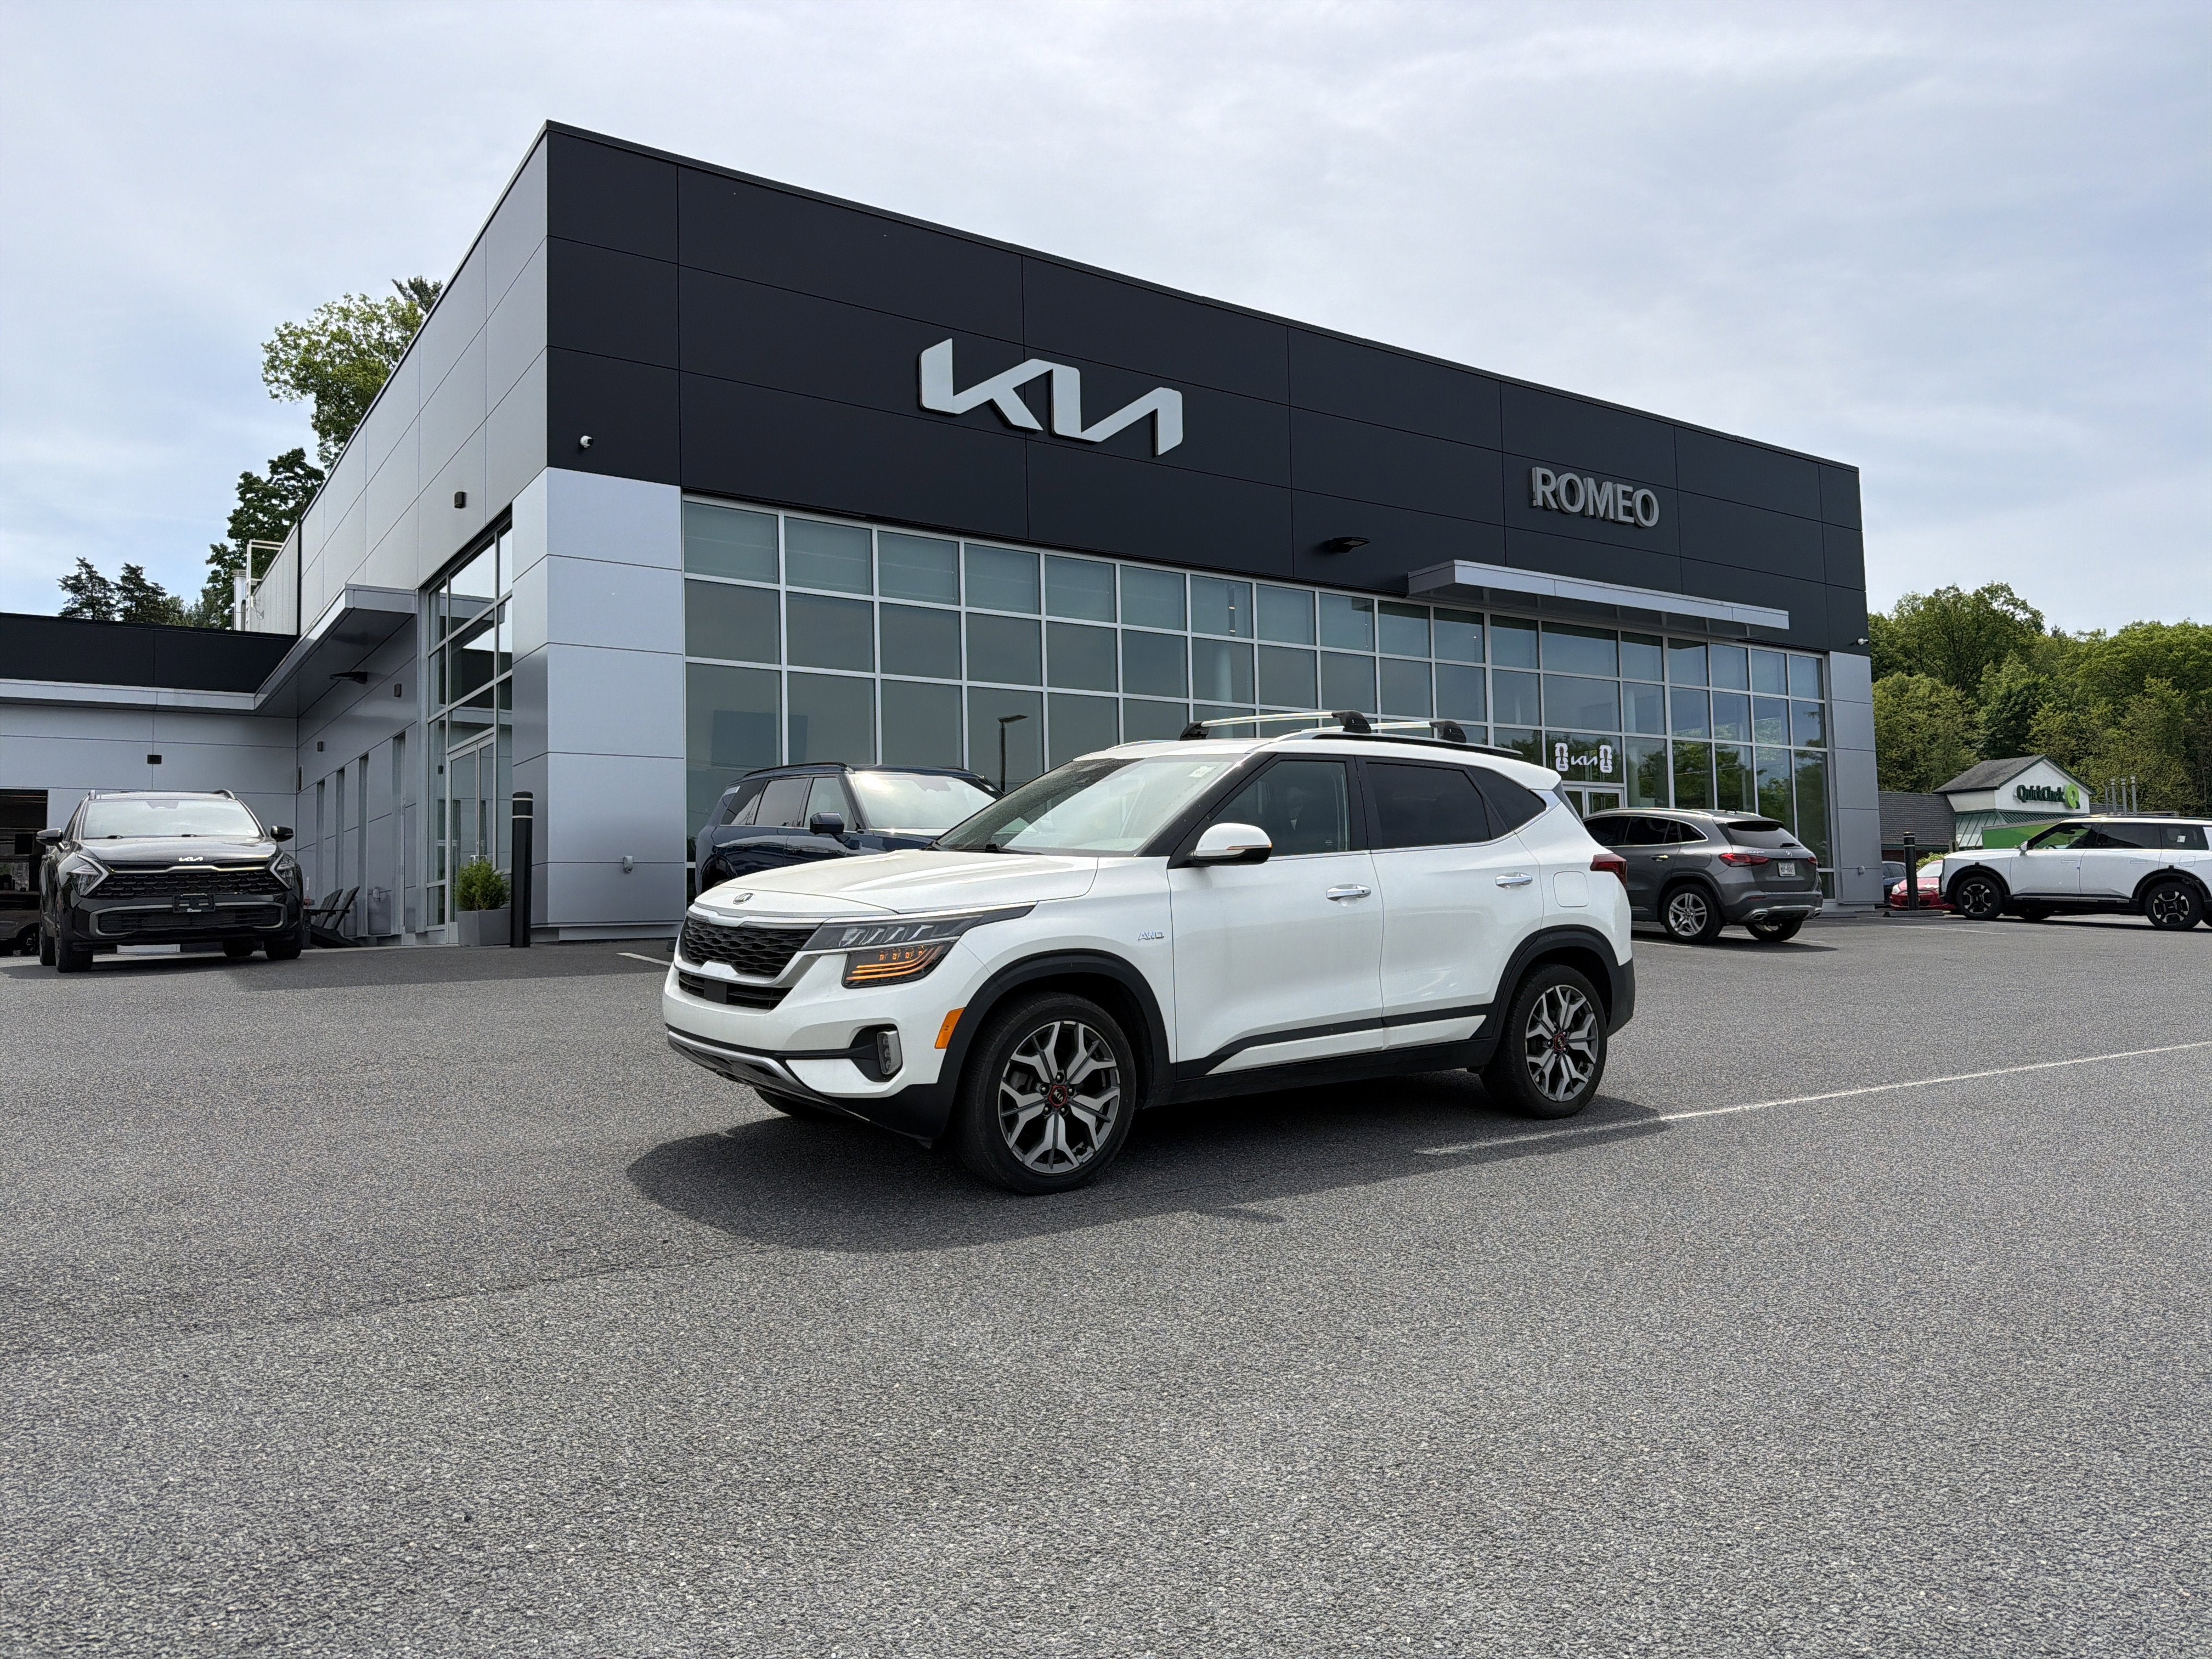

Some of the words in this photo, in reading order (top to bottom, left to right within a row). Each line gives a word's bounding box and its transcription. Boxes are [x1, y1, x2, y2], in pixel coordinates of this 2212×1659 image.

[920, 337, 1183, 456] KIA
[1532, 466, 1660, 527] ROMEO
[1571, 755, 1598, 766] KIA
[1138, 931, 1165, 941] AWD
[1053, 1089, 1064, 1103] KIA
